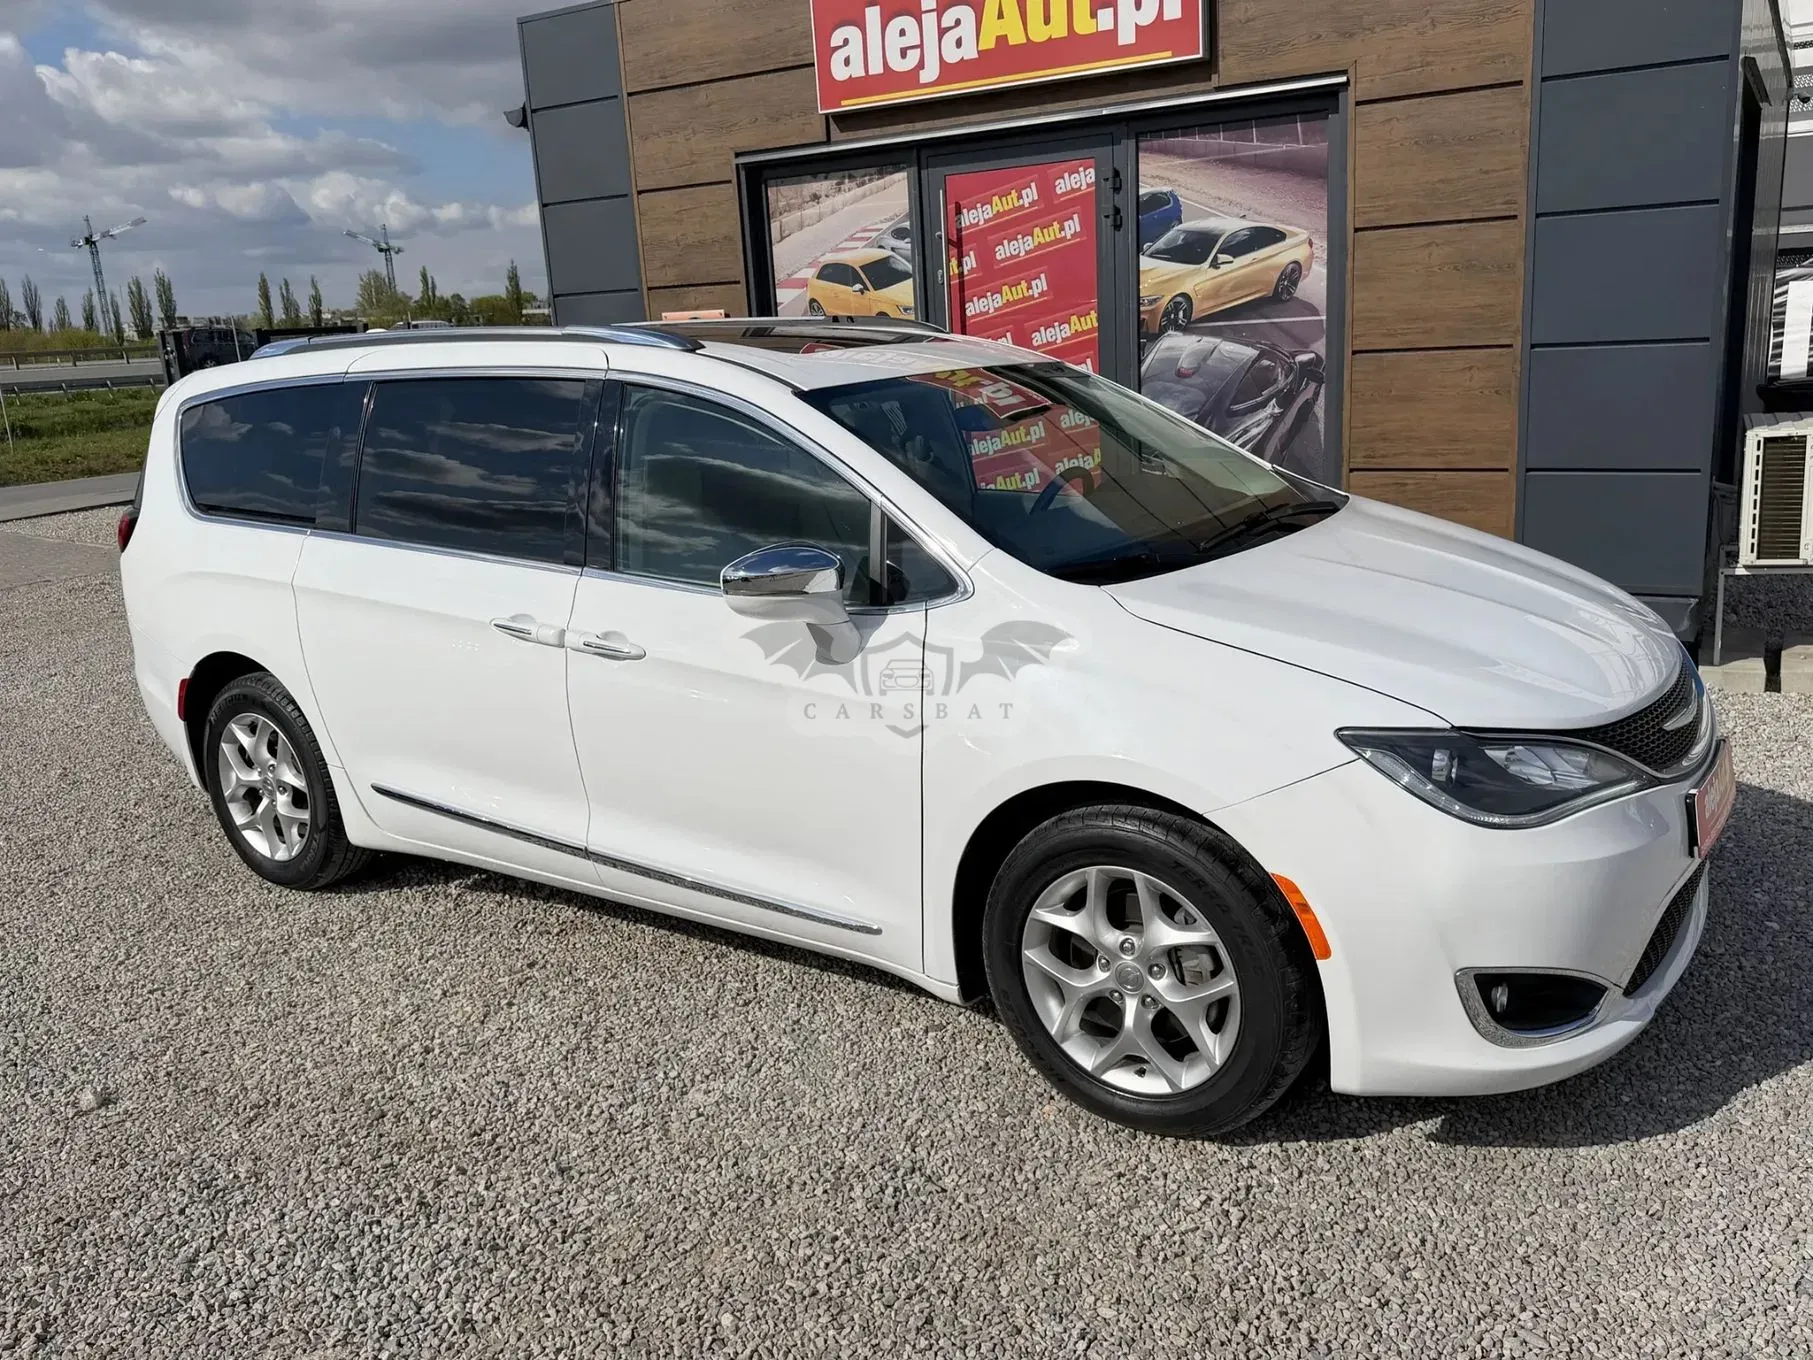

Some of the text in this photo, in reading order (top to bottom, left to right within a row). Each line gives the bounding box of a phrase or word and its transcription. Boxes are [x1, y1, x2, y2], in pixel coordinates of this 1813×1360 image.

[829, 0, 1183, 84] alejaAut.p
[1054, 166, 1096, 195] aleja
[956, 182, 1039, 229] alejaAut.pl
[995, 213, 1081, 261] alejaAut.pl
[965, 273, 1048, 316] alejaAut.pl
[1031, 309, 1098, 347] alejaAut
